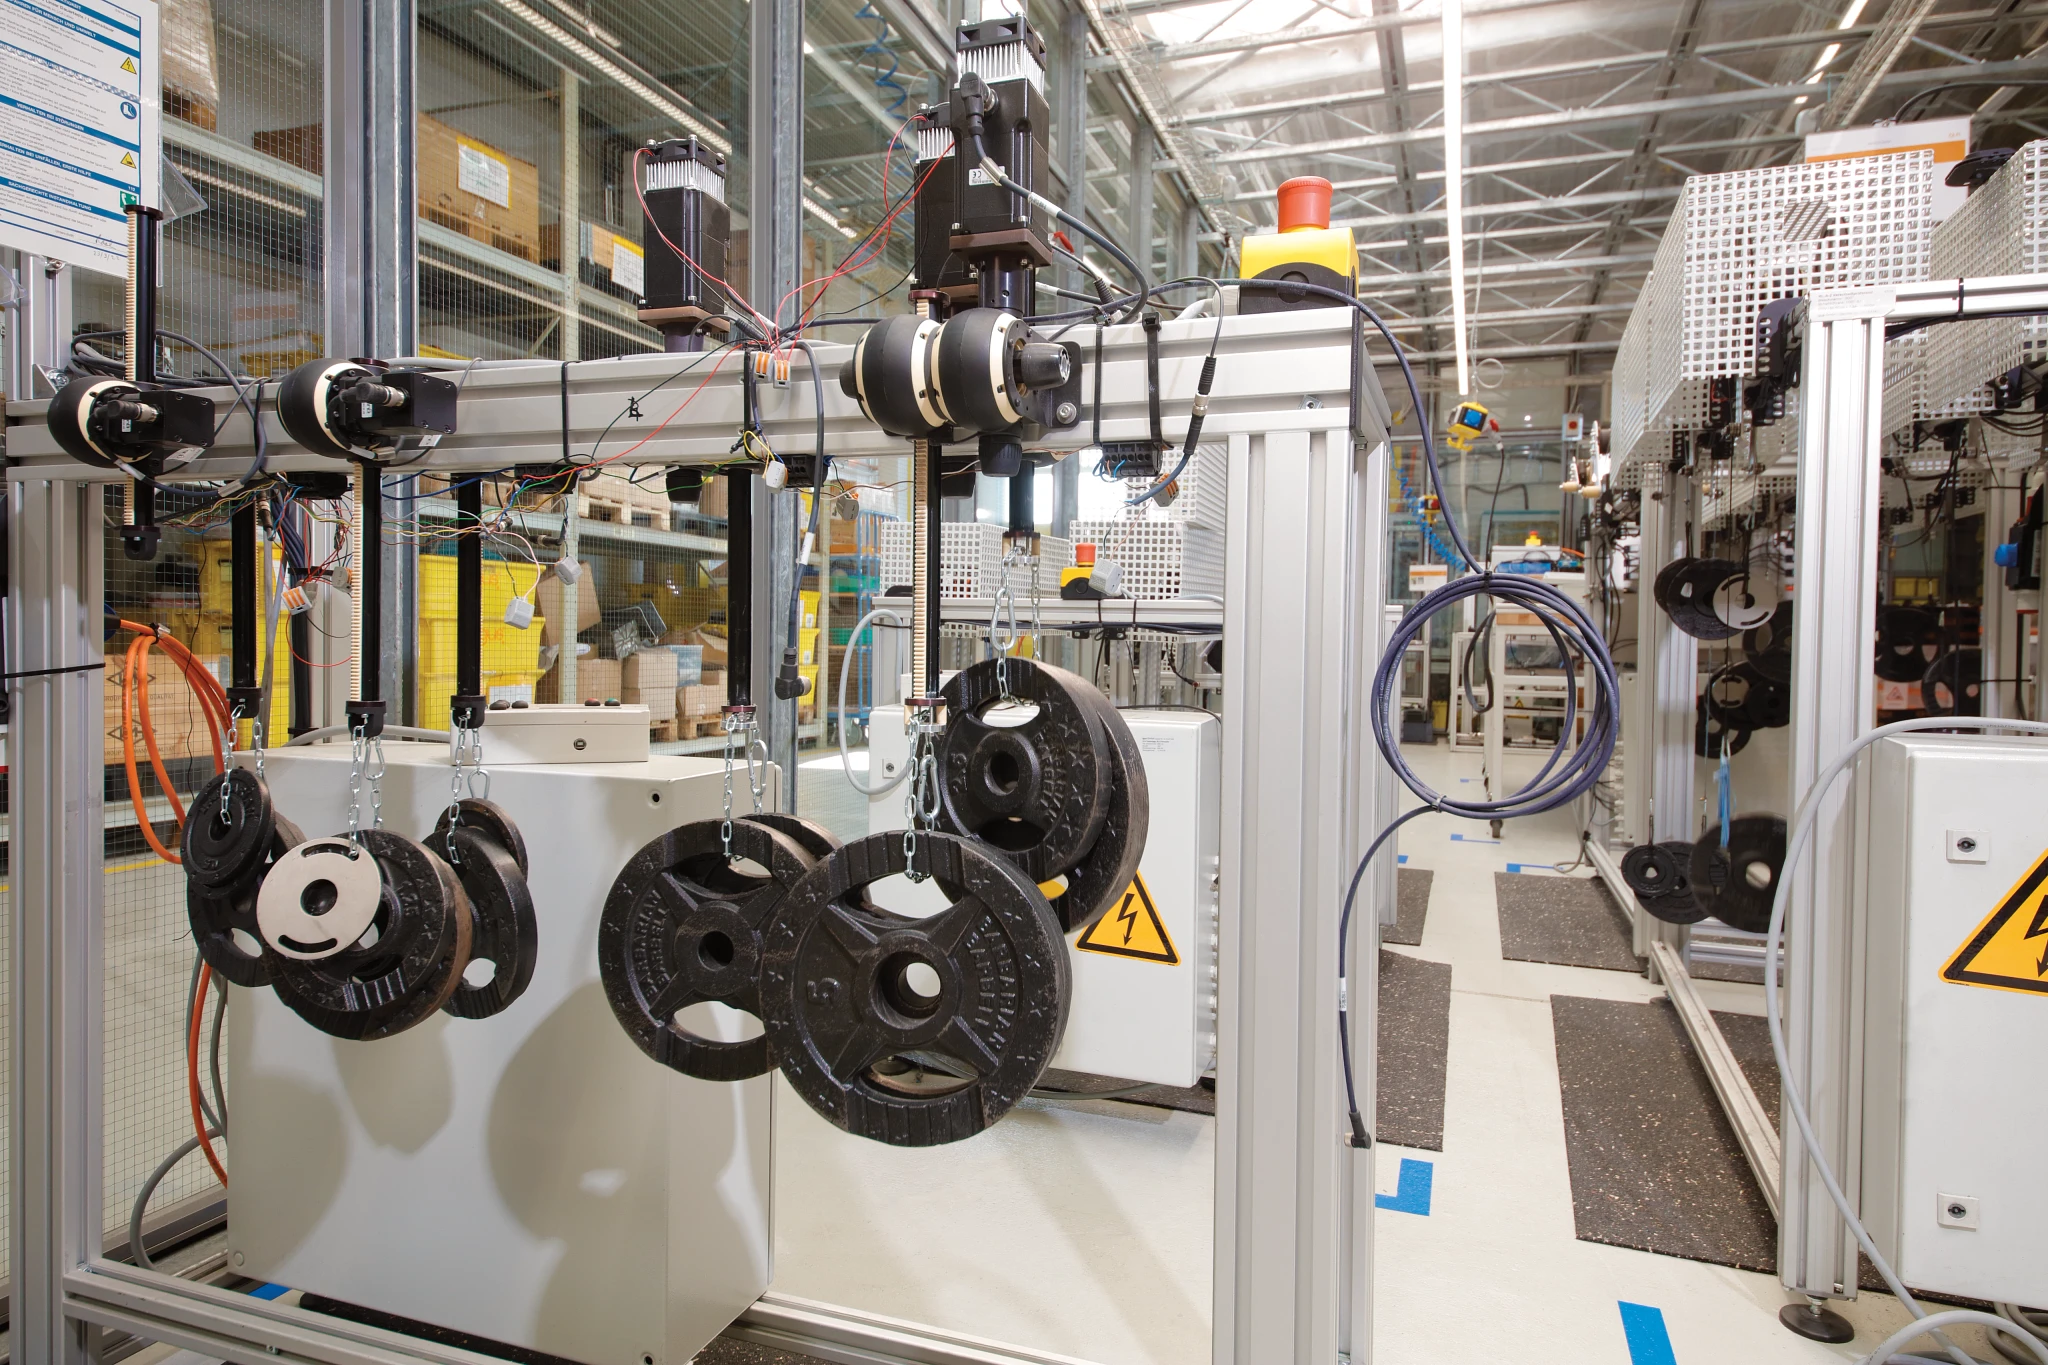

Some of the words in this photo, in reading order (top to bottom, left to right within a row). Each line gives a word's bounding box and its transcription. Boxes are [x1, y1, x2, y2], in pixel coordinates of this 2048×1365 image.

[43, 11, 63, 24] MENSCH
[64, 20, 74, 29] UND
[75, 25, 95, 38] UMWELT
[16, 102, 45, 117] VERHALTEN
[55, 116, 84, 131] STÖRUNGEN
[26, 150, 34, 158] BEI
[35, 154, 61, 167] UNFÄLLEN,
[62, 163, 77, 172] ERSTE
[77, 168, 90, 177] HILFE
[8, 181, 47, 197] SACHGERECHTE
[48, 193, 91, 210] INSTANDHALTUNG
